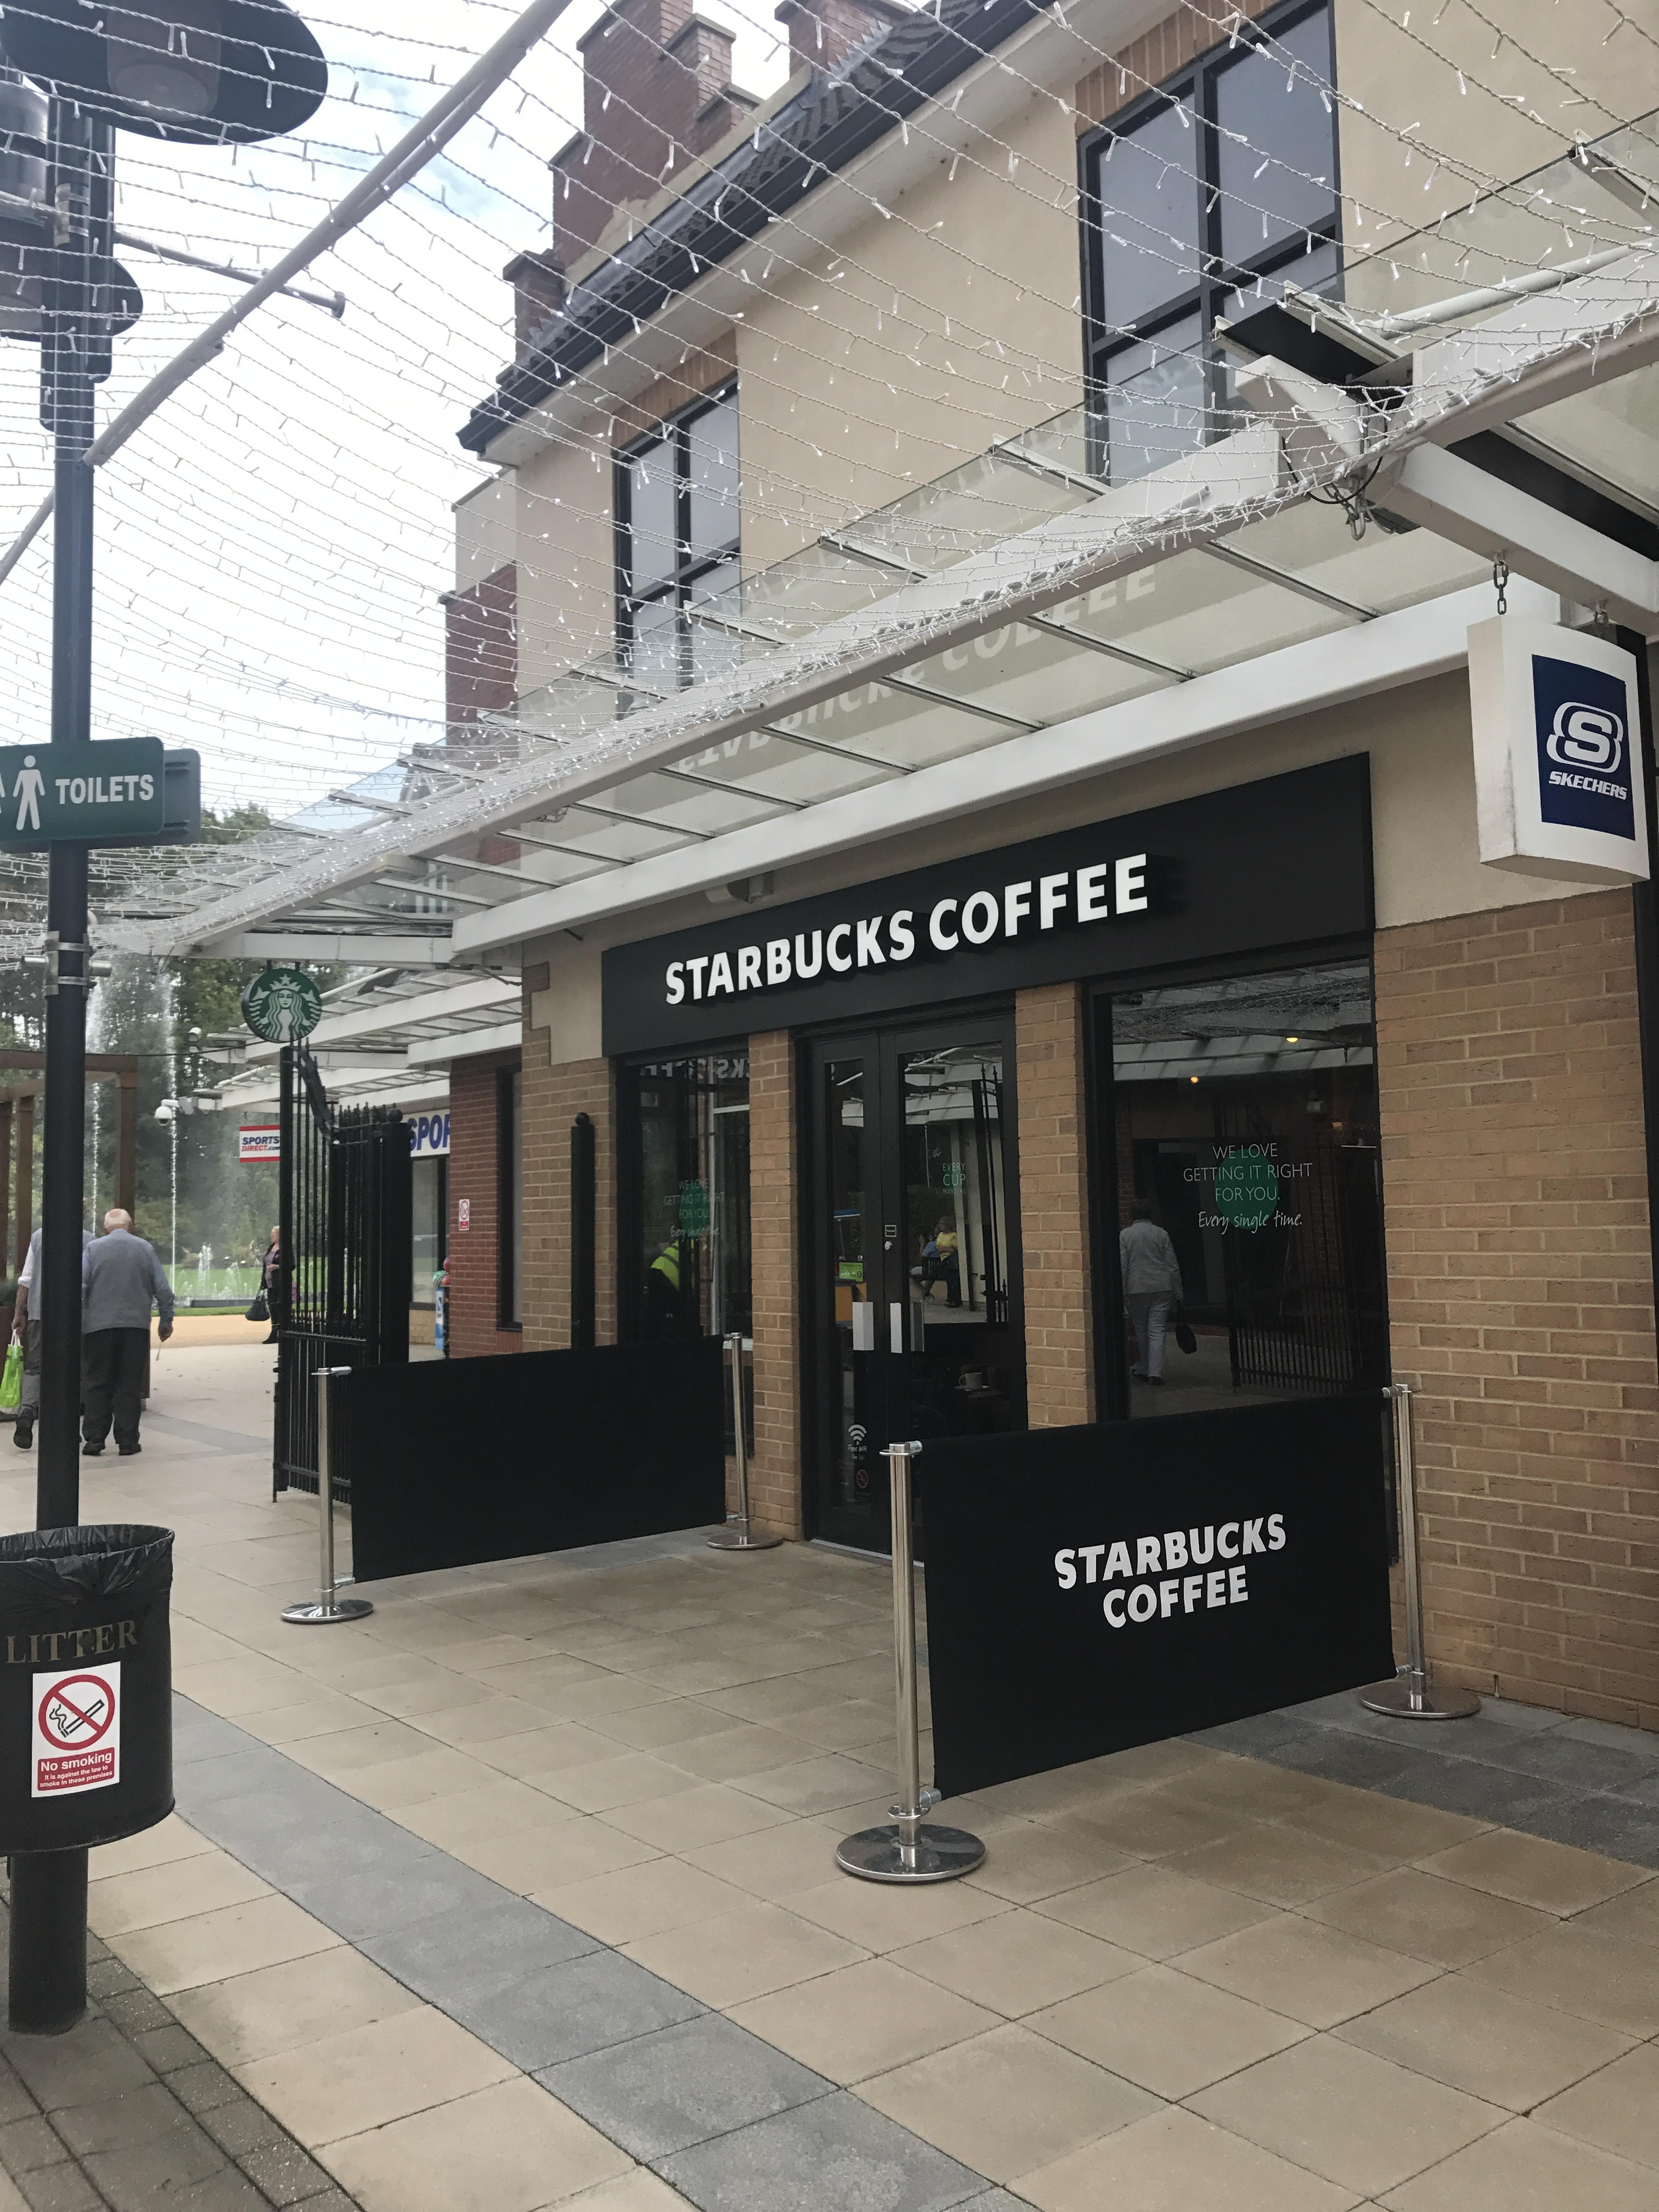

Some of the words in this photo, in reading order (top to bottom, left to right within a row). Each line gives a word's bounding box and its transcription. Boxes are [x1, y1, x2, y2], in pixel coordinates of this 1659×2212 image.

[55, 774, 154, 804] TOILETS
[1548, 771, 1628, 800] SKECHERS
[665, 910, 915, 1005] STARBUCKS
[929, 853, 1148, 951] COFFEE
[242, 1136, 280, 1145] SPORTS
[1212, 1145, 1235, 1159] WE
[1241, 1142, 1278, 1158] LOVE
[943, 1163, 966, 1171] EVERY
[1183, 1166, 1244, 1182] GETTING
[1249, 1165, 1262, 1179] IT
[1267, 1163, 1313, 1178] RIGHT
[943, 1173, 966, 1186] CUP
[1215, 1187, 1244, 1201] FOR
[1245, 1186, 1280, 1201] YOU.
[1198, 1211, 1229, 1234] Every
[1234, 1210, 1269, 1234] single
[1274, 1210, 1302, 1228] time.
[1054, 1514, 1286, 1589] STARBUCKS
[1103, 1565, 1248, 1628] COFFEE
[5, 1620, 138, 1663] LITTER
[41, 1761, 58, 1771] No
[61, 1752, 112, 1770] smoking
[57, 1771, 79, 1780] against
[86, 1770, 112, 1782] premises
